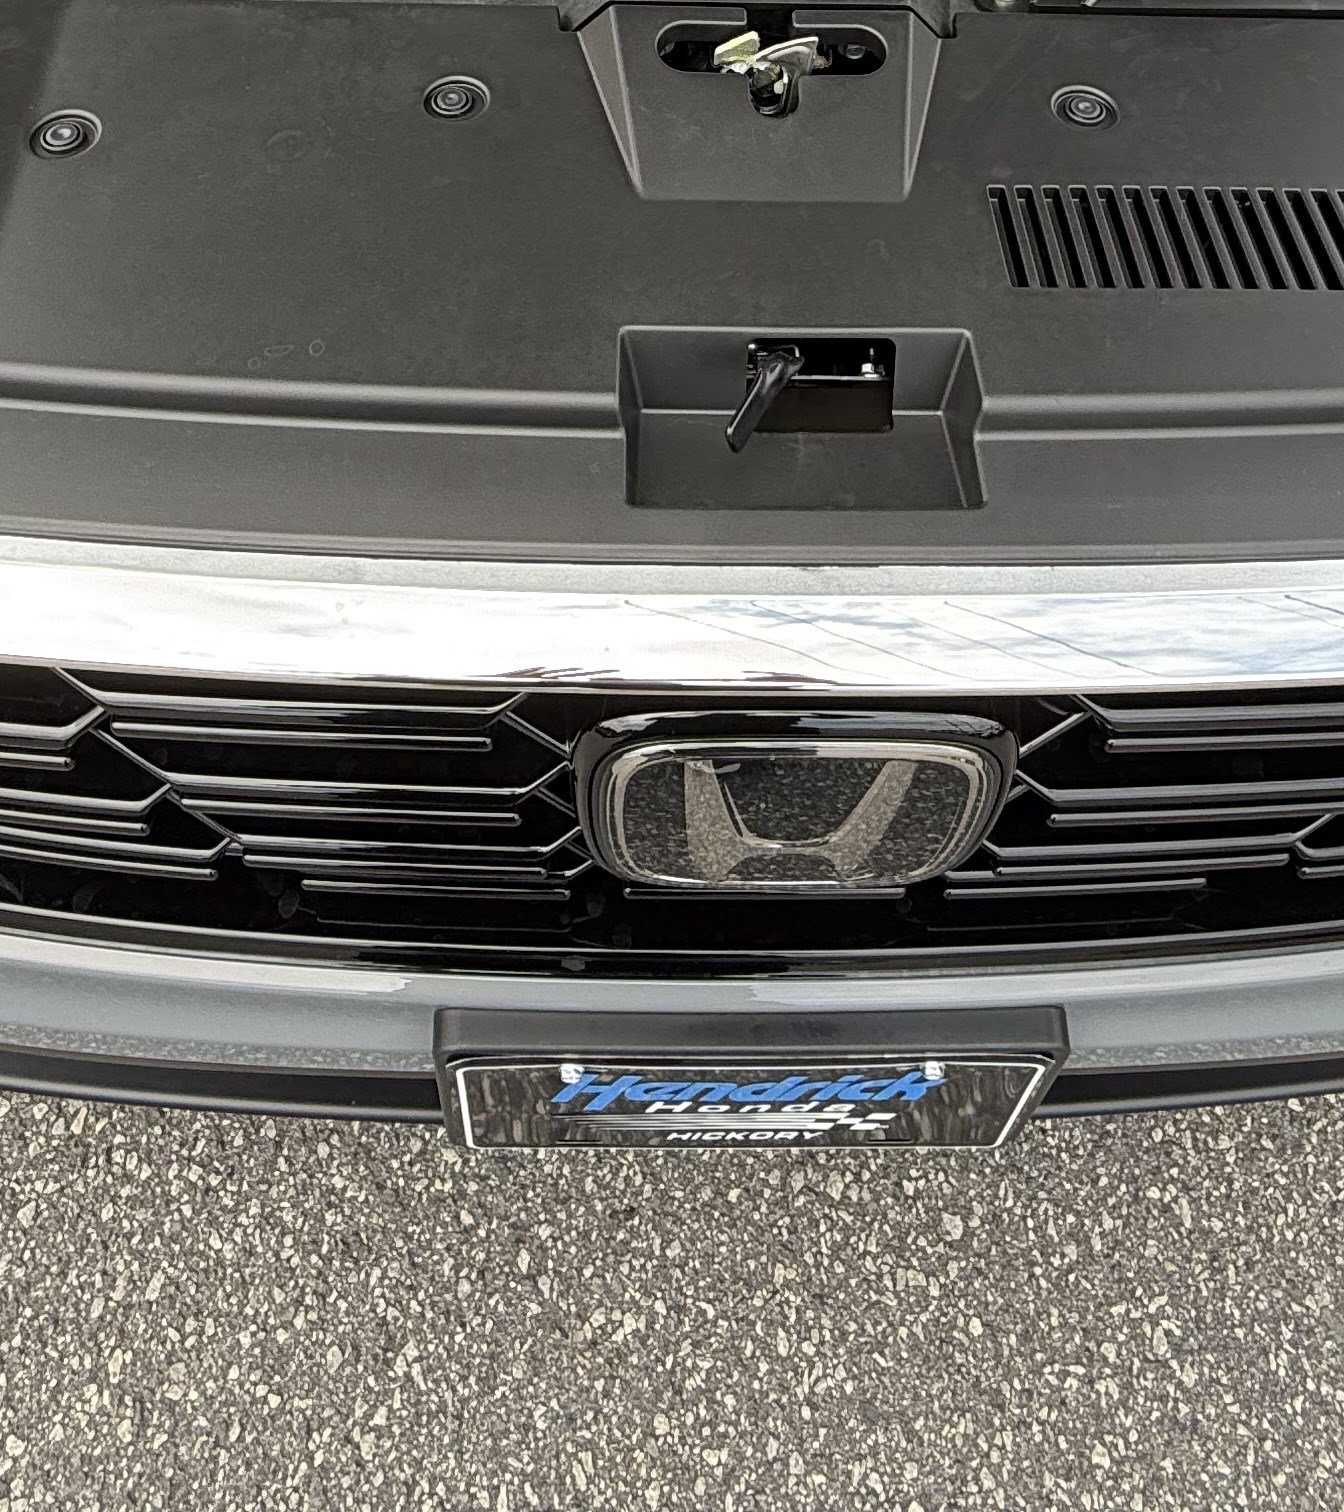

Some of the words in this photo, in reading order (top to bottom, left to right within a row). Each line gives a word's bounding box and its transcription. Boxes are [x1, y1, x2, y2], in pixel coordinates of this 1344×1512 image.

[550, 1070, 948, 1112] Hendrick
[644, 1101, 856, 1114] Honda
[666, 1131, 824, 1141] HICKORY
